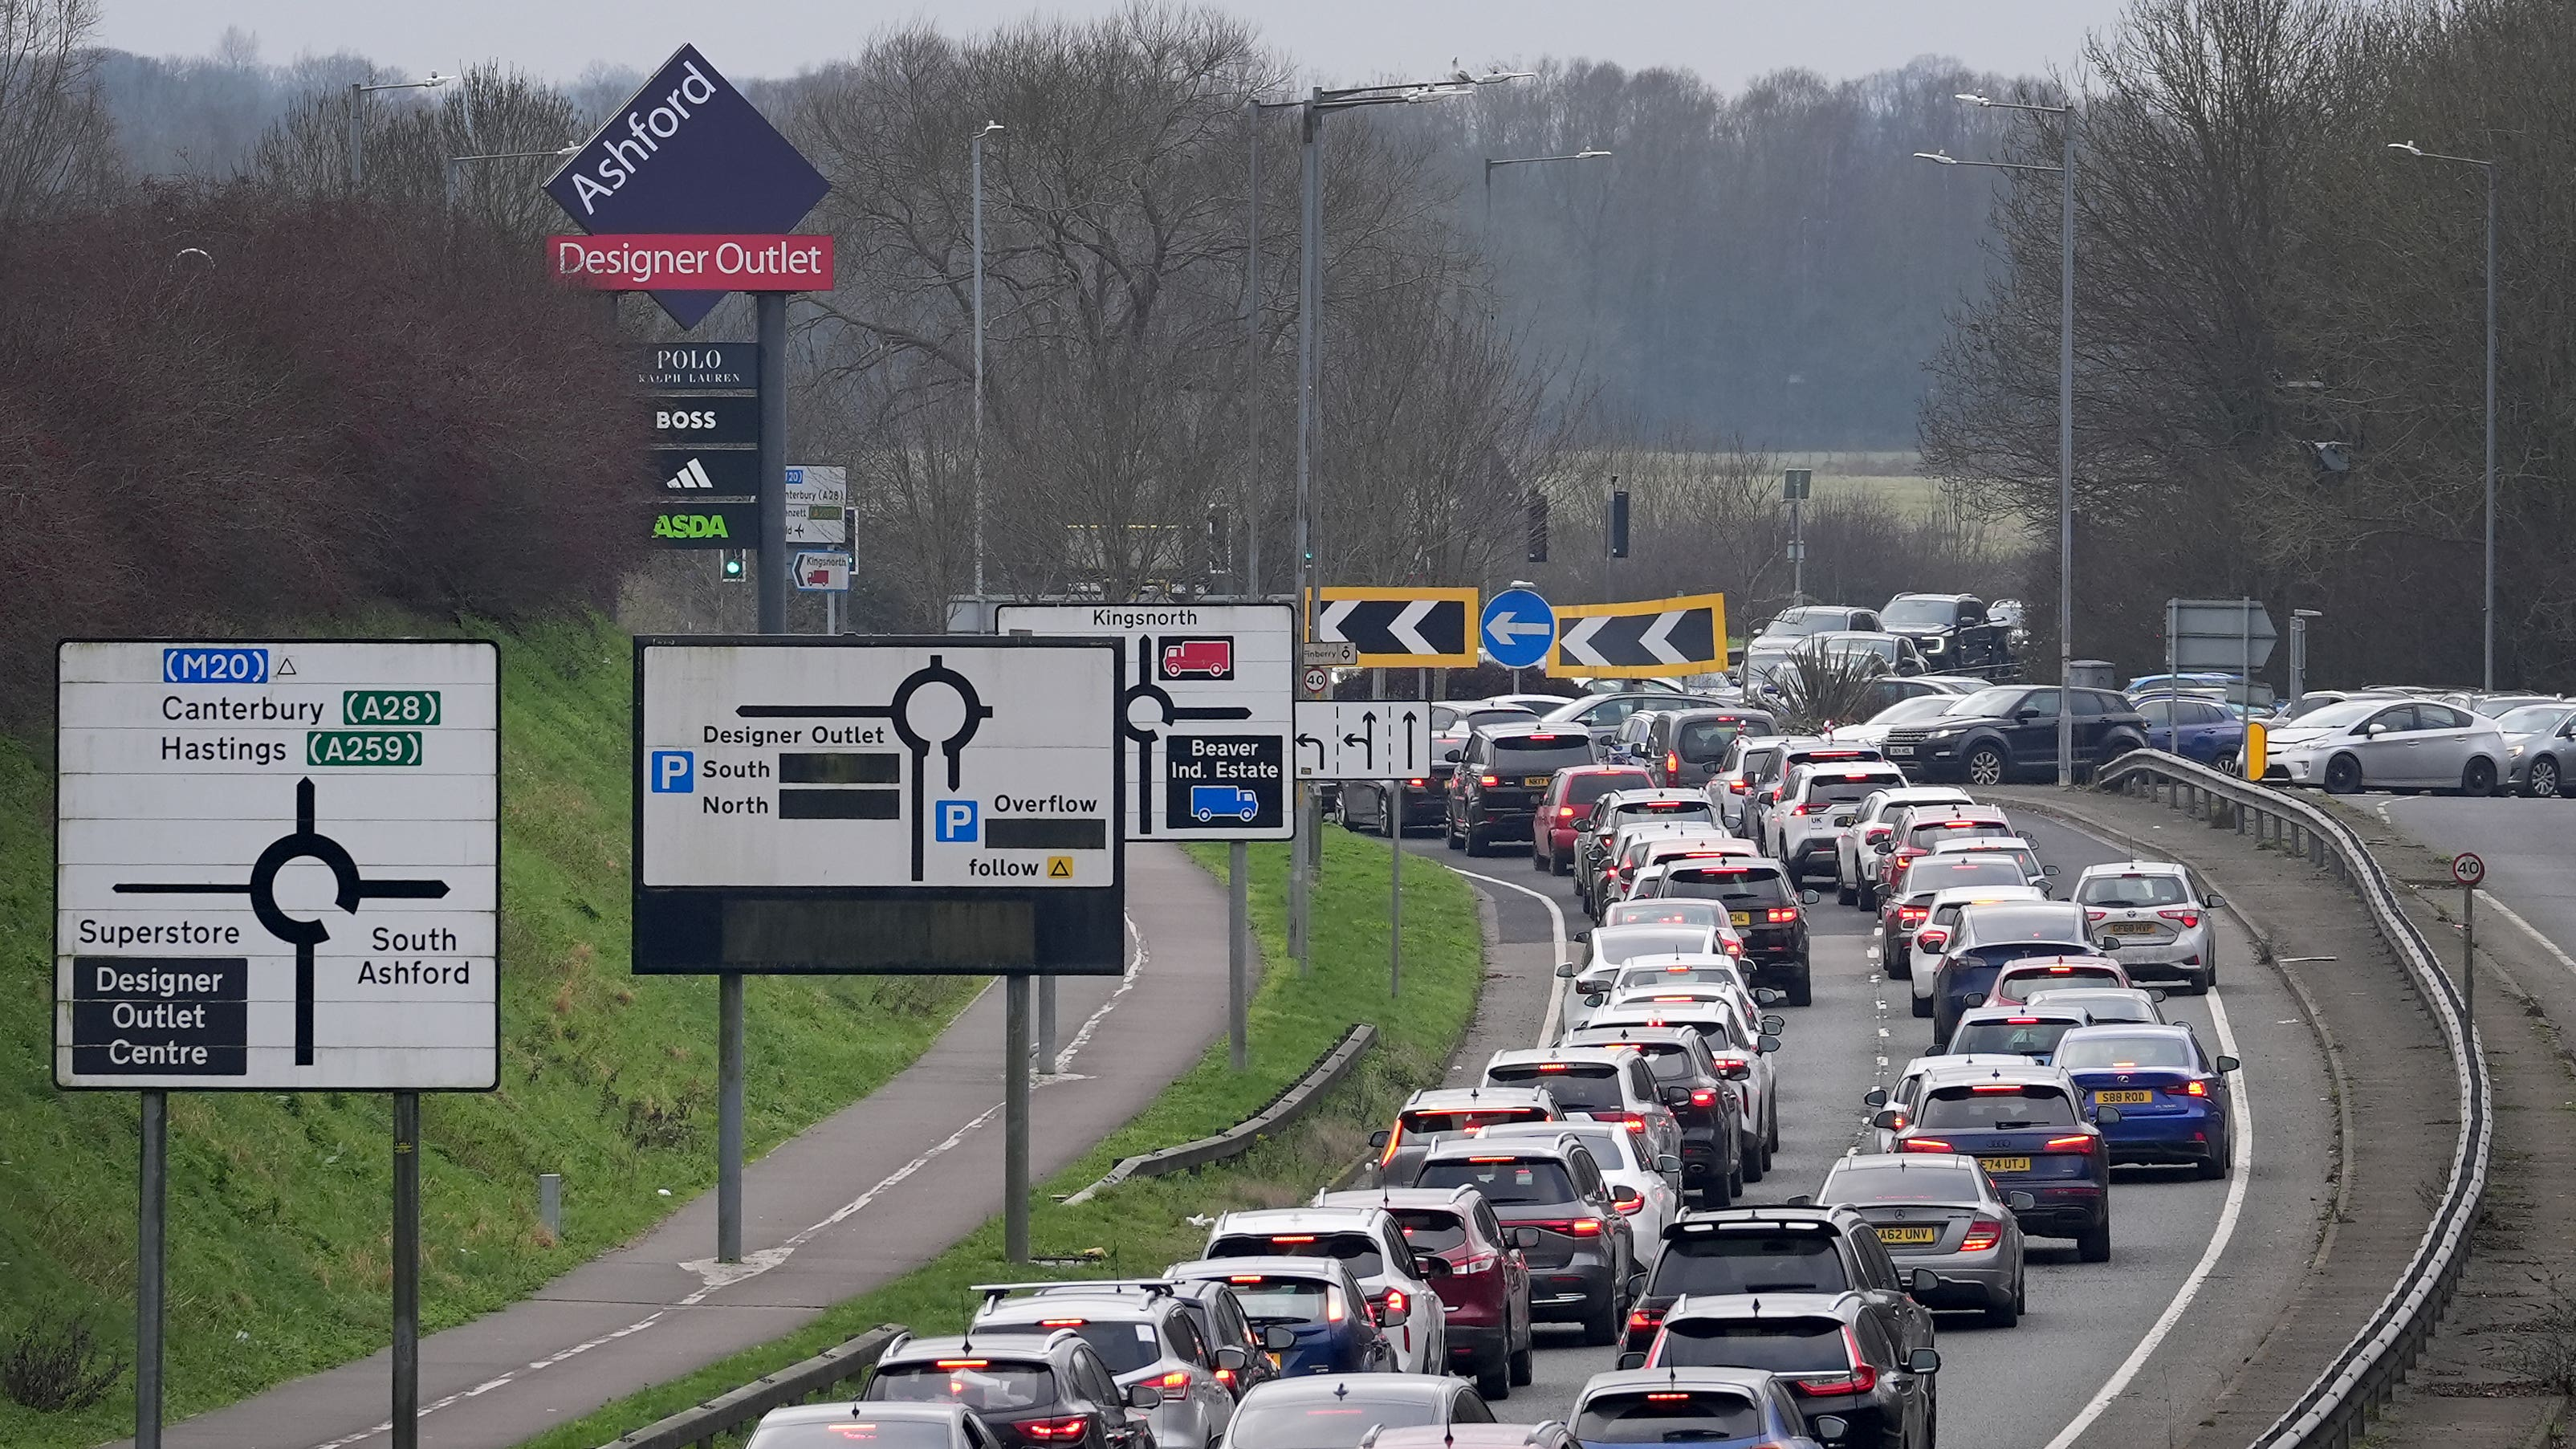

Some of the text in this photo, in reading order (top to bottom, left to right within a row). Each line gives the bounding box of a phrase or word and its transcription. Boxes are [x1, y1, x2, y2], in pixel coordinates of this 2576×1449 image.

[570, 59, 717, 215] Ashford
[558, 241, 822, 283] Designer Outlet
[657, 348, 722, 369] POLO
[689, 373, 740, 383] LAUREN
[656, 410, 717, 429] BOSS
[819, 490, 844, 501] (A28)
[652, 514, 729, 539] ASDA
[807, 556, 847, 568] Kingsnorth
[1093, 608, 1198, 629] Kingsnorth
[165, 650, 266, 682] (M20)
[1306, 674, 1325, 686] 40
[162, 692, 438, 726] Canterbury (A28)
[703, 726, 885, 747] Designer Outlet
[161, 733, 421, 765] Hastings (A259)
[1191, 739, 1259, 757] Beaver
[661, 755, 689, 790] P
[702, 760, 771, 779] South
[1171, 760, 1280, 779] Ind. Estate
[702, 796, 769, 815] North
[994, 794, 1097, 813] Overflow
[946, 804, 973, 839] P
[969, 858, 1040, 877] follow
[2457, 861, 2480, 874] 40
[79, 920, 240, 948] Superstore
[372, 926, 458, 952] South
[96, 967, 224, 998] Designer
[357, 960, 470, 985] Ashford
[112, 1003, 206, 1029] Outlet
[108, 1040, 209, 1065] Centre
[2004, 1158, 2026, 1169] UTJ
[1905, 1229, 1927, 1239] UNV
